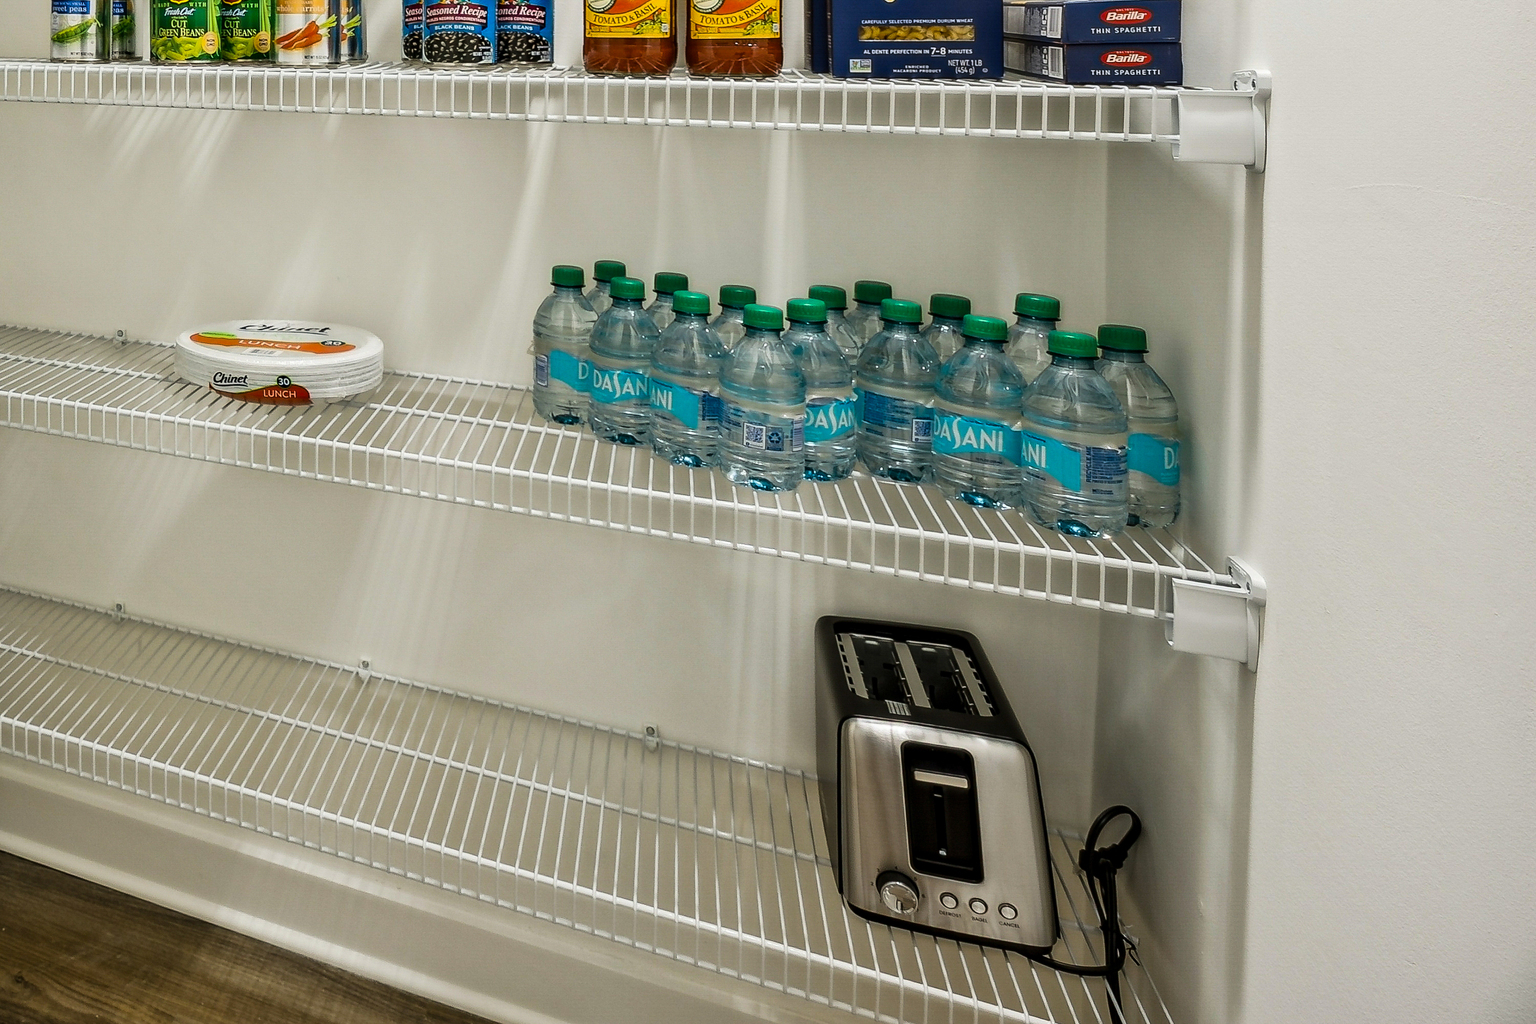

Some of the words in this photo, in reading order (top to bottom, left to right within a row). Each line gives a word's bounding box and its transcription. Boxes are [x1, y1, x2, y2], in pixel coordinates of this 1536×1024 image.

[69, 6, 88, 14] peas
[164, 7, 181, 16] Fresh
[426, 6, 460, 18] Seasoned
[460, 6, 488, 18] Recipe
[520, 6, 546, 18] Recipe
[593, 14, 628, 24] TOMATO
[634, 3, 657, 18] BASIL
[700, 15, 738, 24] TOMATO
[744, 2, 768, 19] BASIL
[1106, 11, 1145, 21] Barilla
[170, 19, 188, 28] CUT
[224, 20, 240, 28] CUT
[159, 28, 178, 36] GREEN
[180, 28, 204, 36] BEANS
[1114, 26, 1161, 34] SPAGHETTI
[930, 47, 946, 55] 7-8
[1106, 54, 1145, 64] Barilla
[955, 66, 968, 74] (454
[239, 324, 331, 333] Chinet
[238, 340, 302, 350] LUNCH
[213, 372, 248, 384] Chinet
[278, 378, 290, 386] 30
[263, 390, 296, 398] LUNCH
[934, 416, 1004, 452] DASANI
[939, 910, 962, 918] DEFROST
[972, 916, 988, 924] BAGEL
[998, 921, 1020, 929] CANCEL
